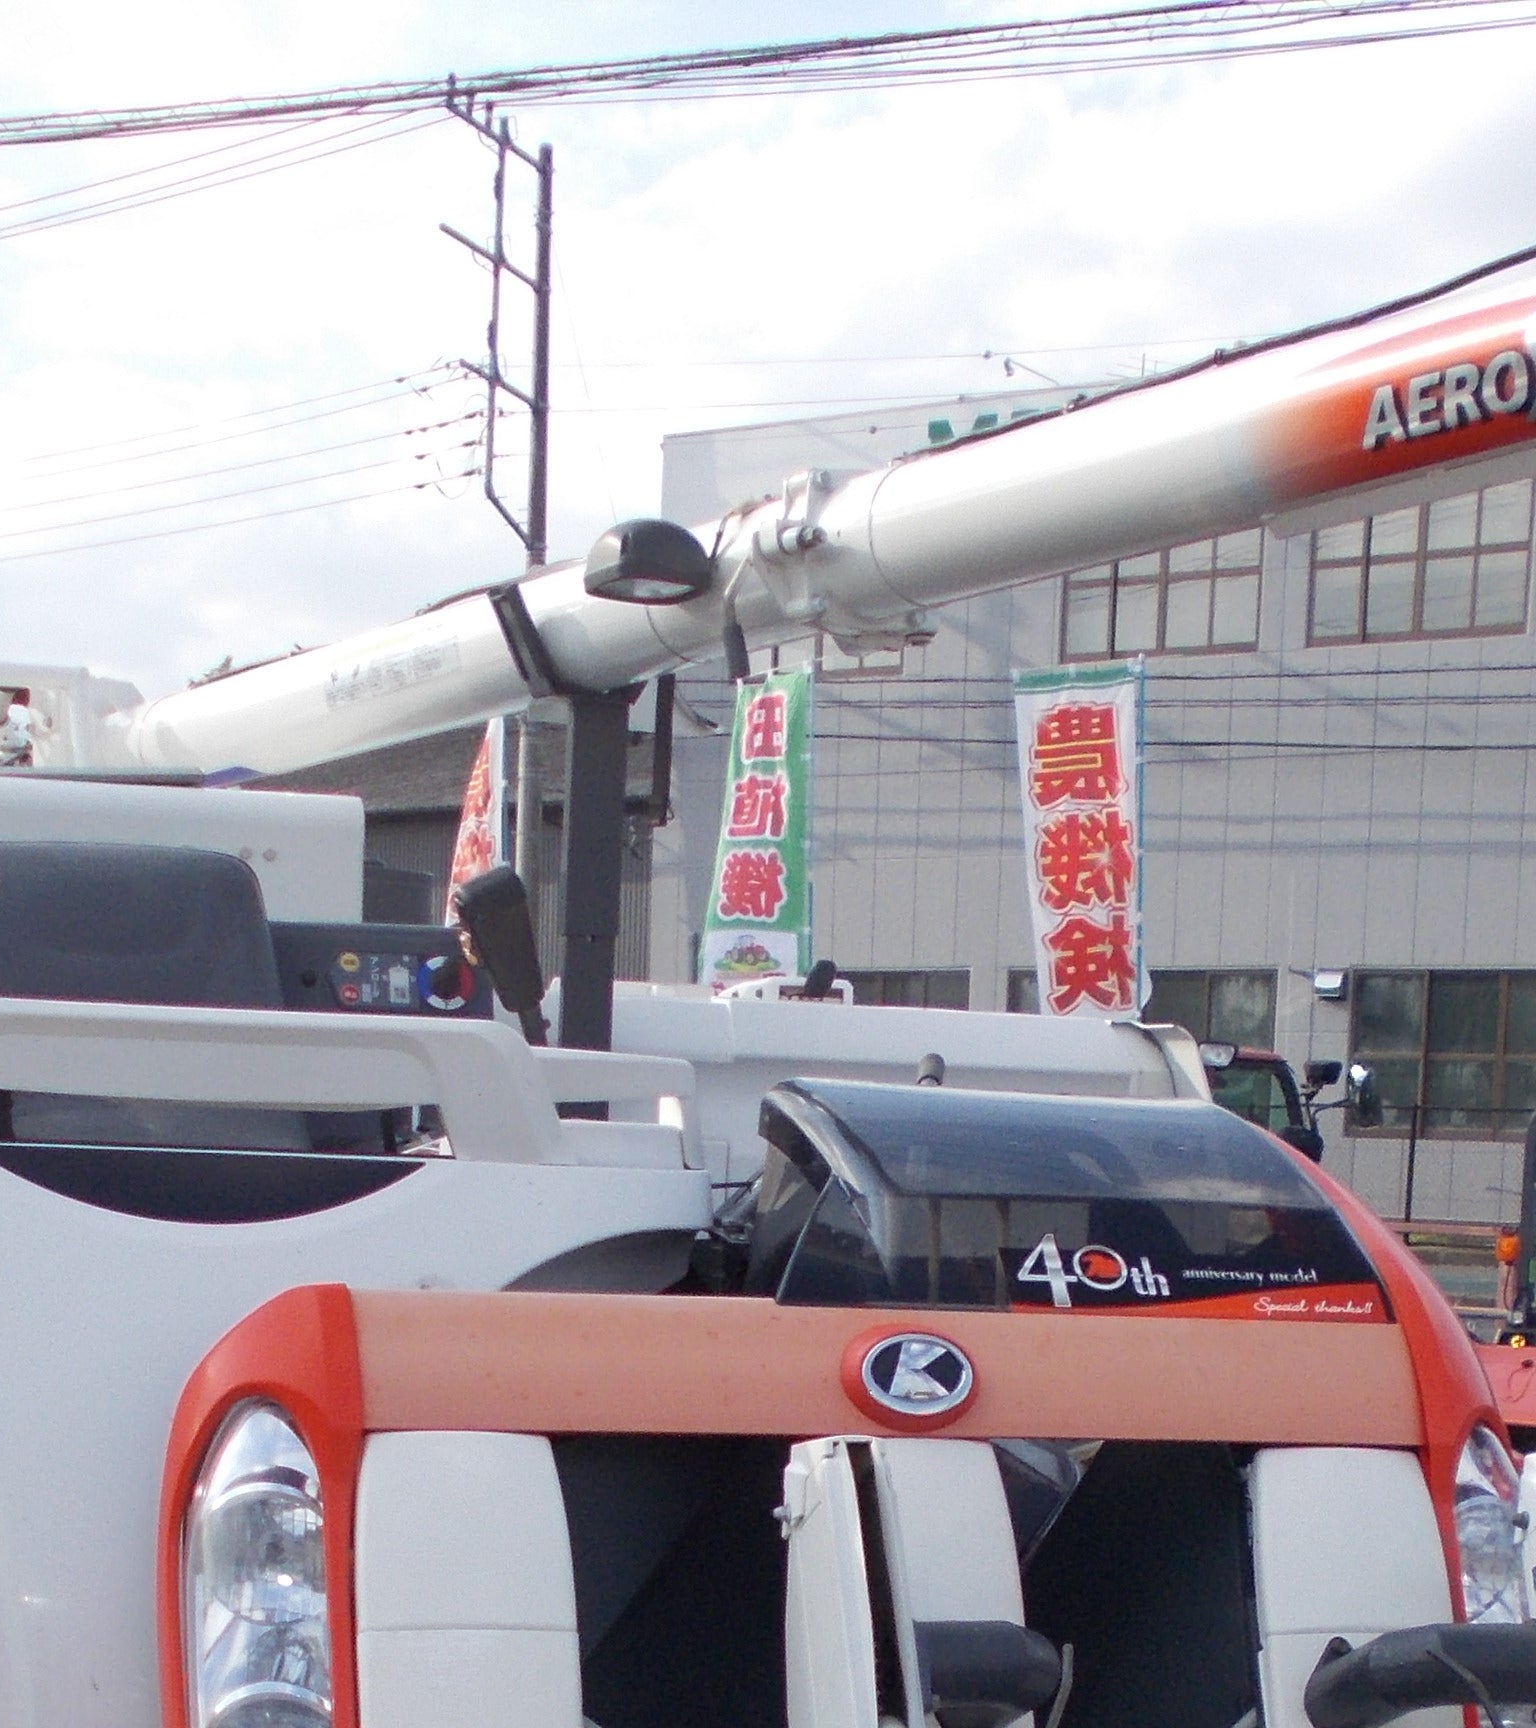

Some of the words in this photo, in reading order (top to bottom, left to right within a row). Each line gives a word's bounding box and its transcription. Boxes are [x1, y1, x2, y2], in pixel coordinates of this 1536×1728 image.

[1017, 1234, 1171, 1308] 40th
[1182, 1267, 1264, 1287] anniversary
[1269, 1267, 1318, 1283] model
